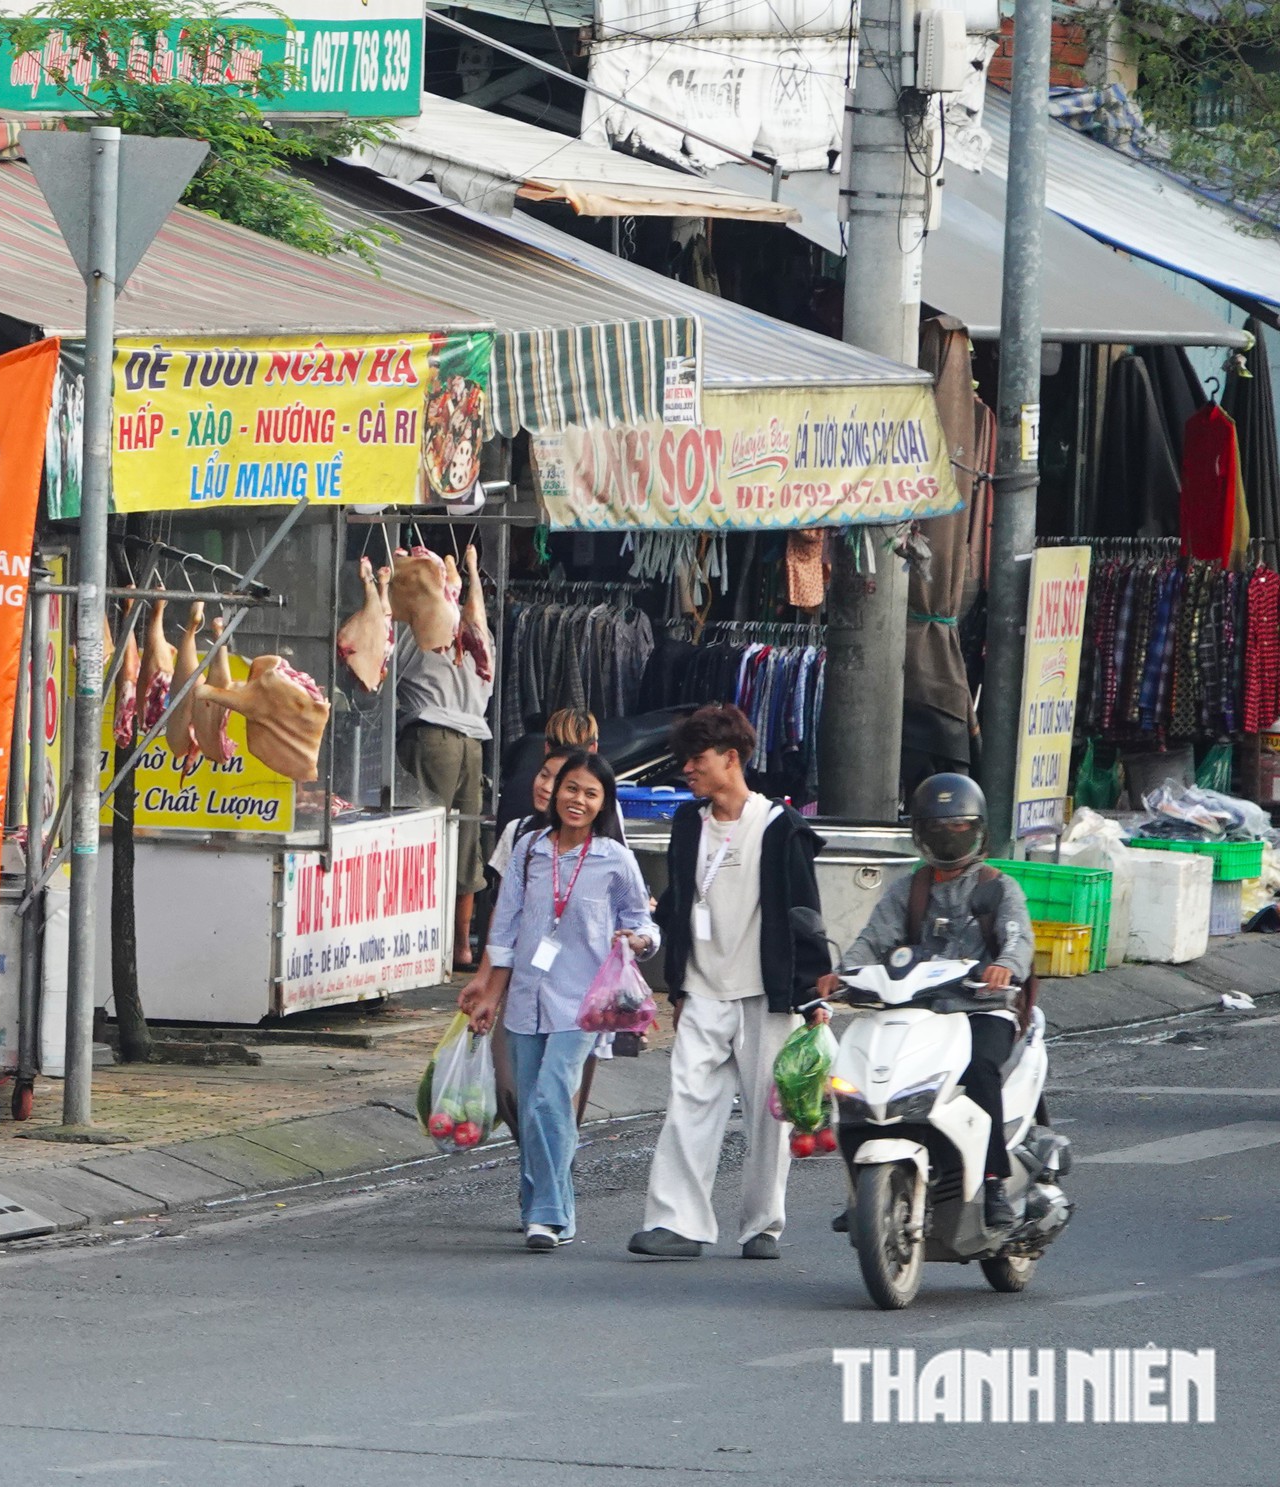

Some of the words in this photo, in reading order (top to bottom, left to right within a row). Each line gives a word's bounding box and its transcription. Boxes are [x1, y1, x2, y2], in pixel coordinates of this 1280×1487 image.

[311, 30, 348, 93] 0977
[352, 30, 380, 93] 768
[384, 29, 411, 92] 339
[264, 342, 365, 386] NGÂN
[118, 402, 164, 451] HẤP
[187, 402, 233, 447] XÀO
[254, 401, 335, 445] NƯỚNG
[358, 400, 387, 445] CÀ
[395, 409, 418, 445] RI
[840, 404, 870, 468] SỐNG
[189, 450, 230, 501] LẨU
[235, 461, 308, 501] MANG
[316, 451, 344, 498] VỀ
[144, 786, 199, 812] Chất
[206, 790, 280, 822] Lượng
